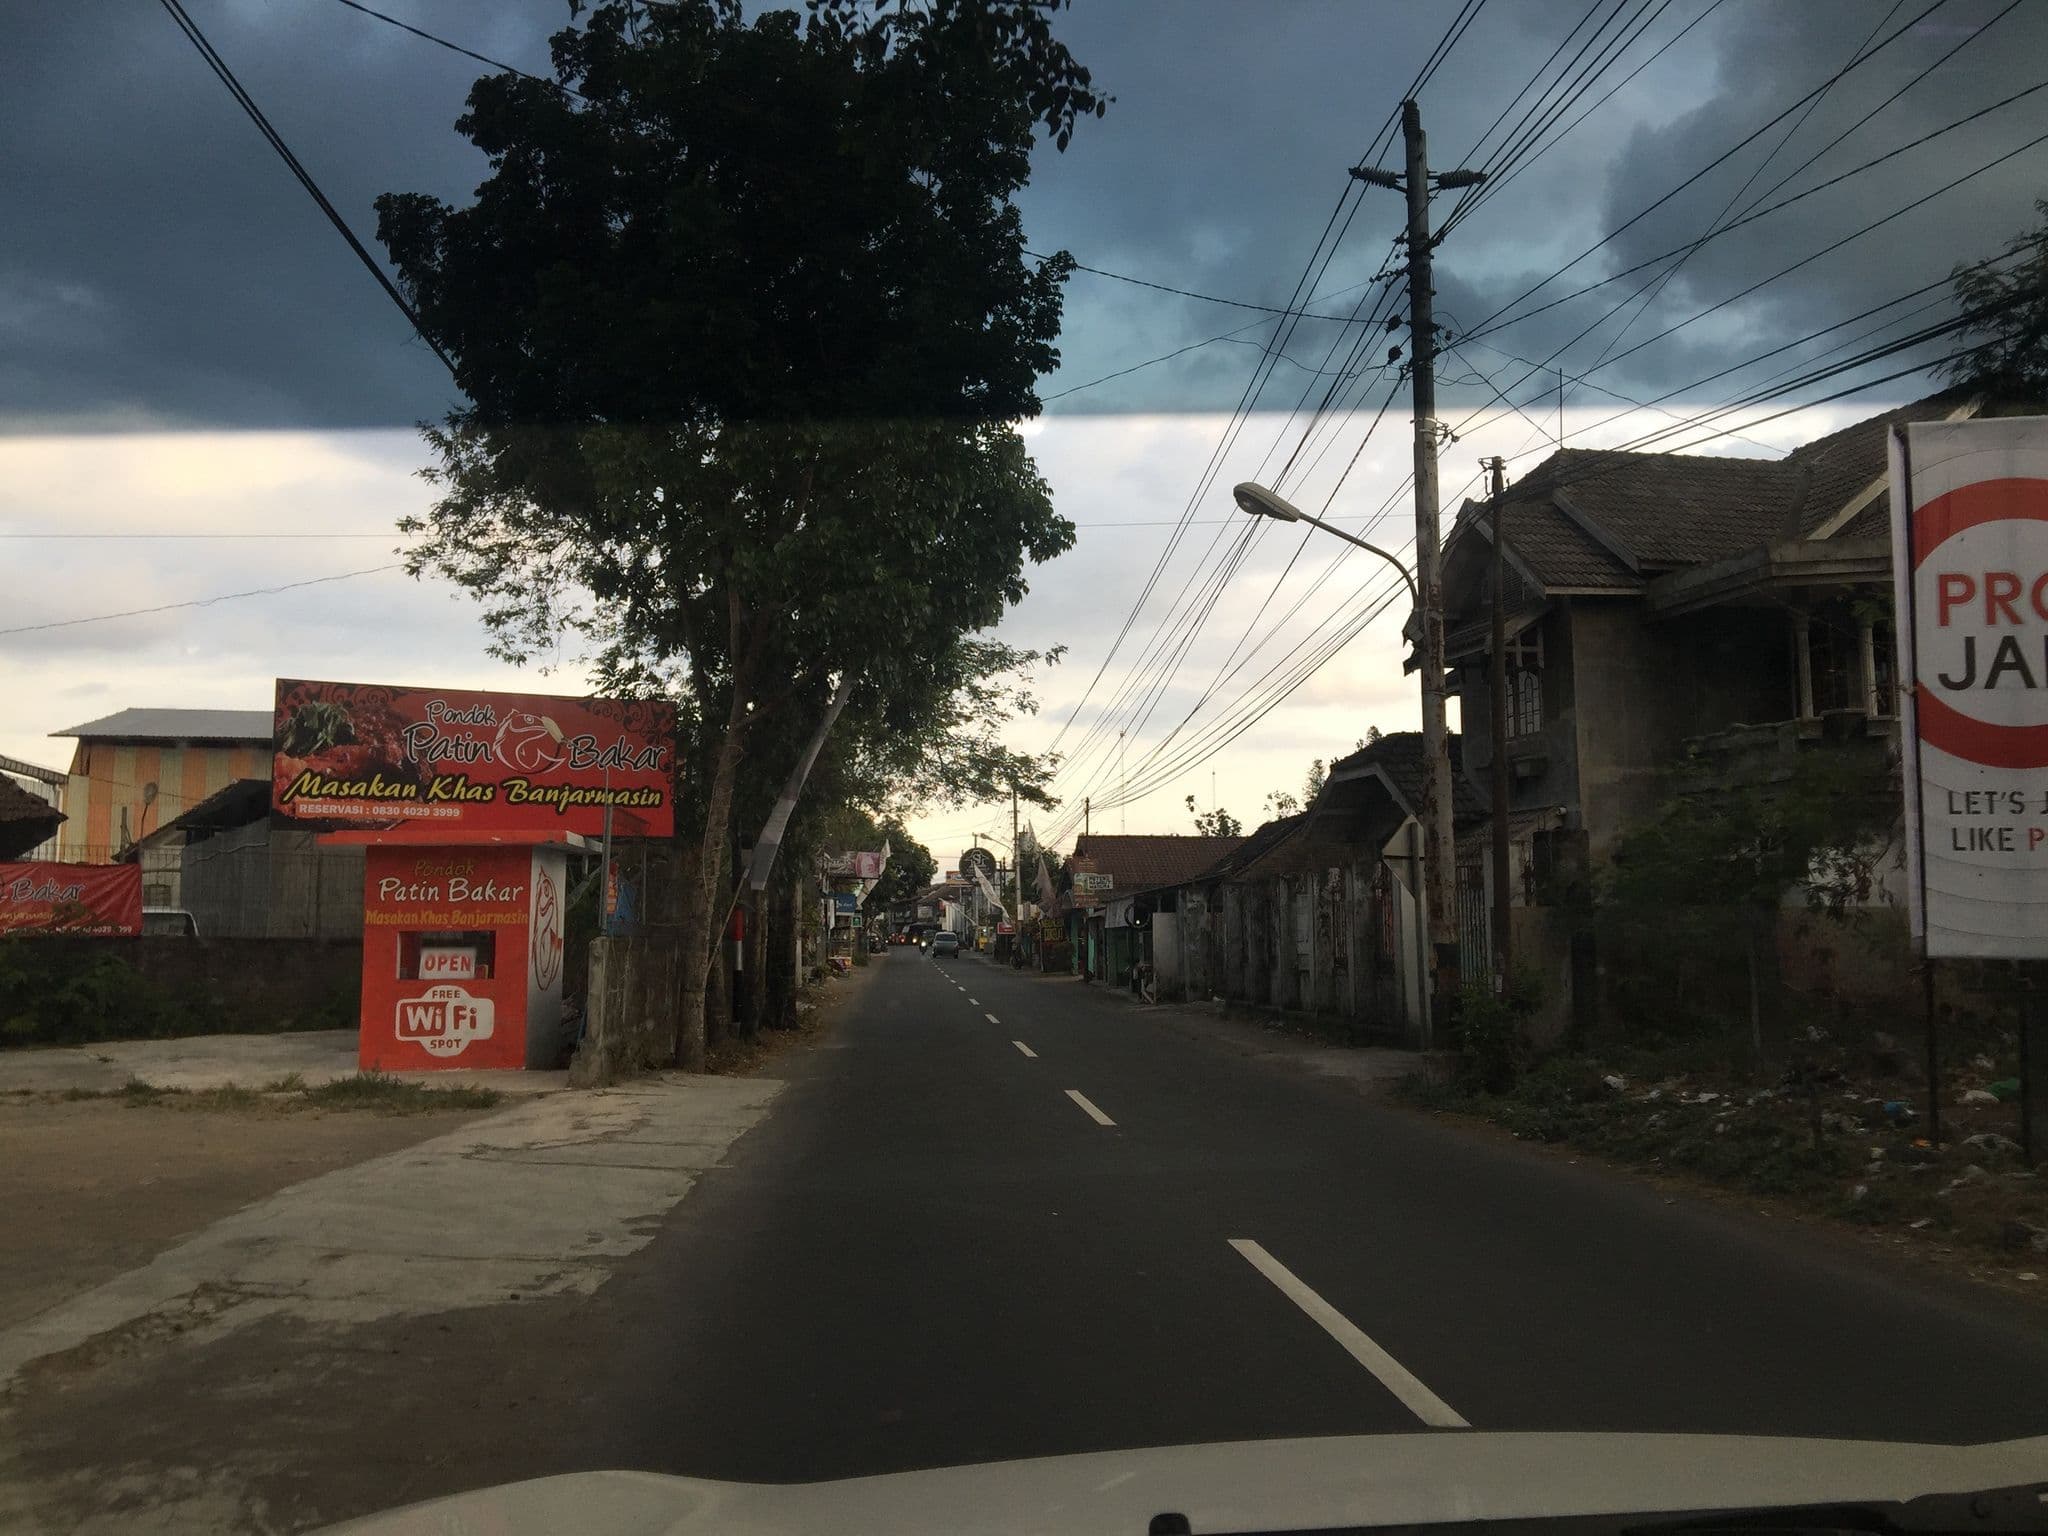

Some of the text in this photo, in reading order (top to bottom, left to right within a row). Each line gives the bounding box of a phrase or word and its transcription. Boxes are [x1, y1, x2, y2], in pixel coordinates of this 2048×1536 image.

[1938, 635, 2048, 690] JA
[425, 699, 497, 726] Pondok
[402, 722, 667, 771] Patin Bakar
[283, 770, 661, 811] Masakan Khas Banjarmasin
[1948, 790, 2025, 815] LET'S
[299, 804, 363, 814] RESERVASI
[402, 807, 430, 816] 4029
[1952, 827, 2015, 852] LIKE
[415, 859, 475, 877] Pondok
[10, 877, 87, 903] Bakar
[379, 877, 524, 902] Patin Bakar
[366, 910, 529, 927] Masakan Khas Banjarmasin
[424, 954, 472, 973] OPEN
[431, 990, 461, 999] FREE
[430, 1039, 462, 1049] SPOT
